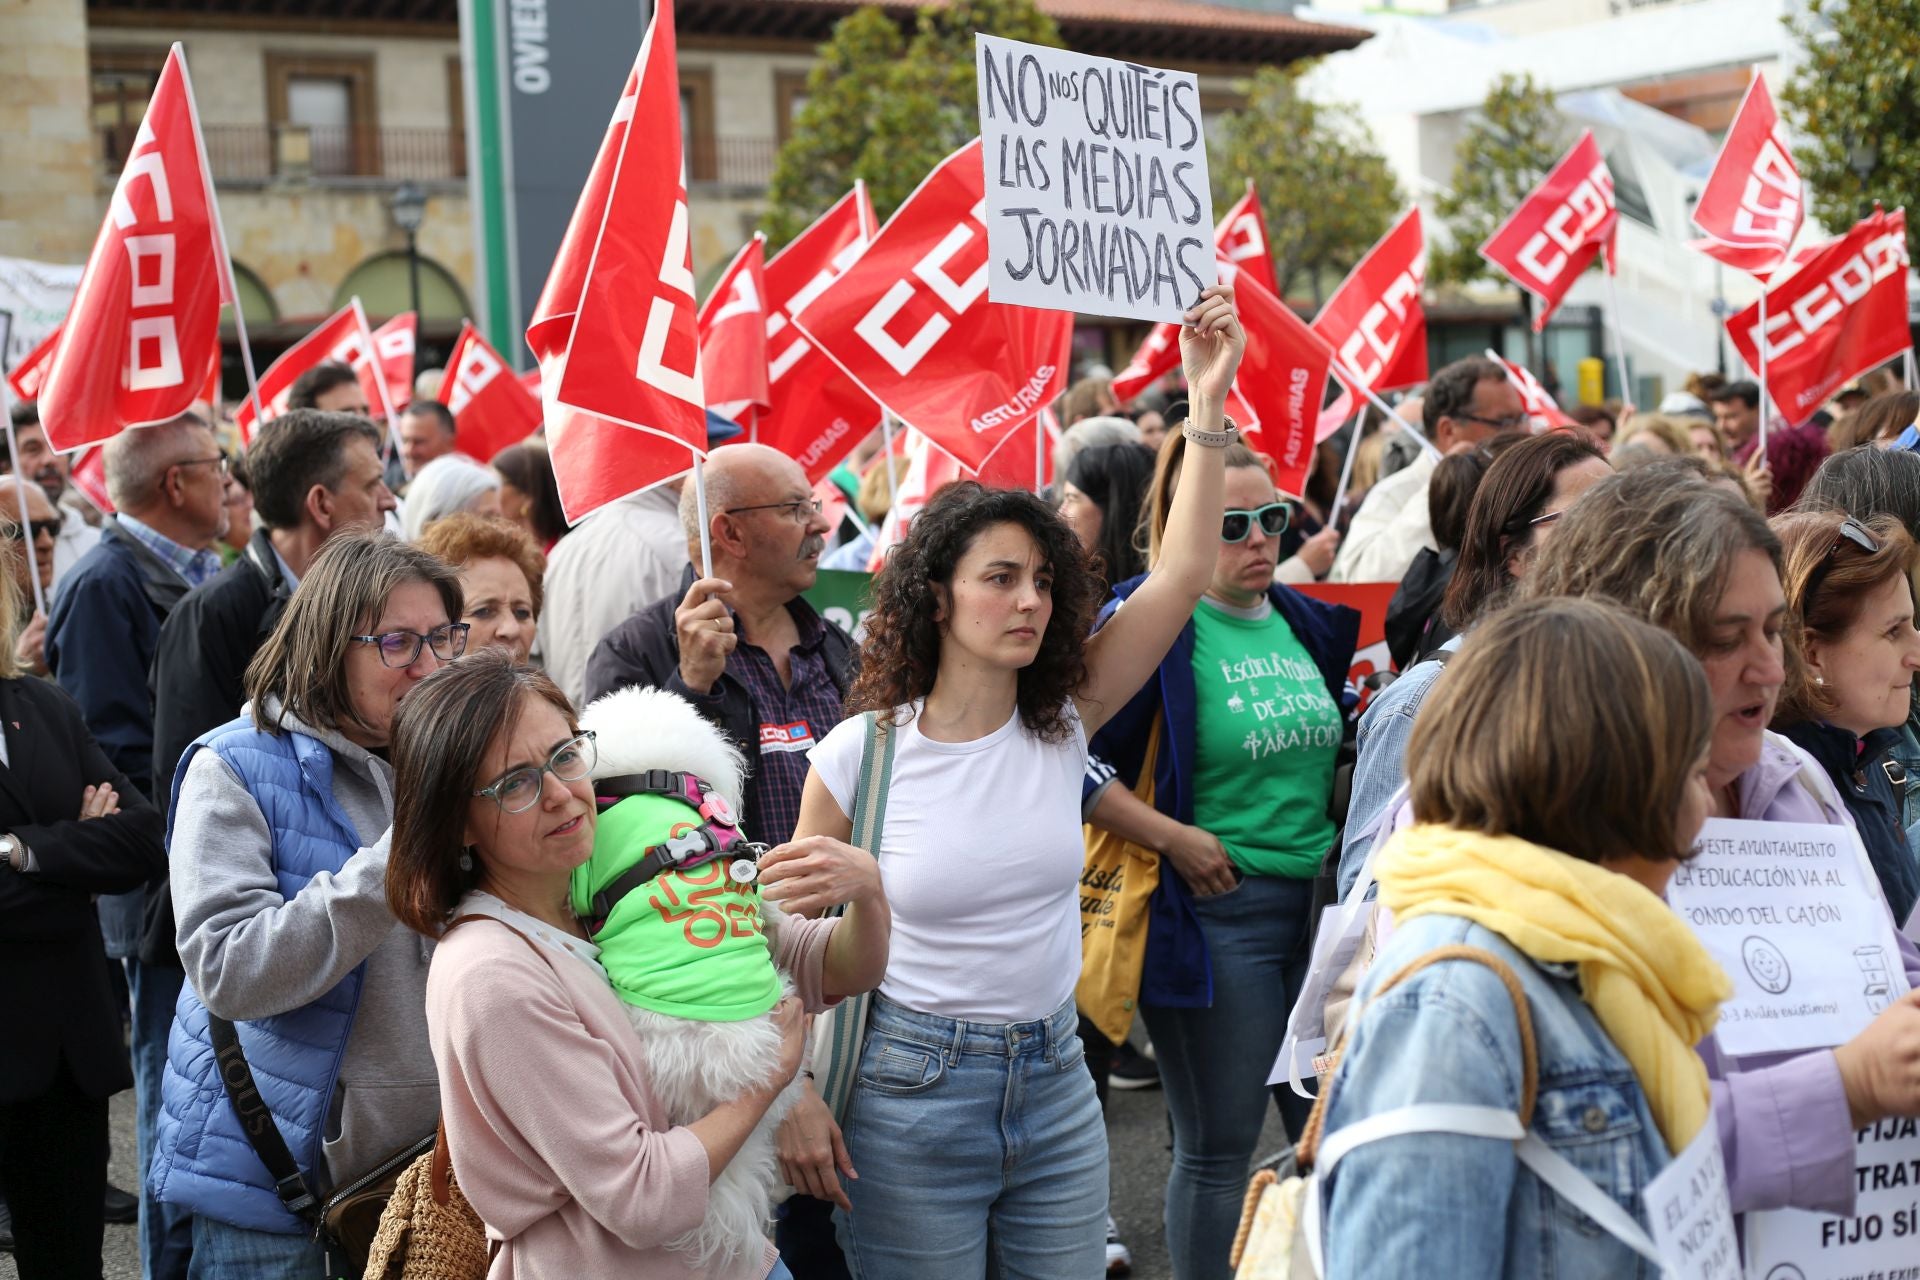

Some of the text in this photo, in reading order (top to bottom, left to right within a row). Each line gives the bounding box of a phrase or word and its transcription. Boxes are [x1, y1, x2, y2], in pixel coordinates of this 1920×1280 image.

[984, 44, 1048, 127] NO
[1049, 70, 1079, 102] NOS
[999, 133, 1202, 225] LAS MEDIAS
[1001, 207, 1207, 312] JORNADAS
[971, 365, 1056, 433] ASTURIAS
[1283, 368, 1310, 468] ASTURIAS
[1303, 725, 1341, 748] TOD
[1698, 865, 1796, 888] EDUCACIÓN
[1798, 869, 1822, 887] VA
[1825, 868, 1847, 887] AL
[1708, 839, 1735, 855] ESTE
[1739, 840, 1837, 858] AYUNTAMIENTO
[1747, 906, 1782, 926] DEL
[1786, 902, 1842, 928] CAJÓN
[1822, 1201, 1918, 1249] FIJO SÍ
